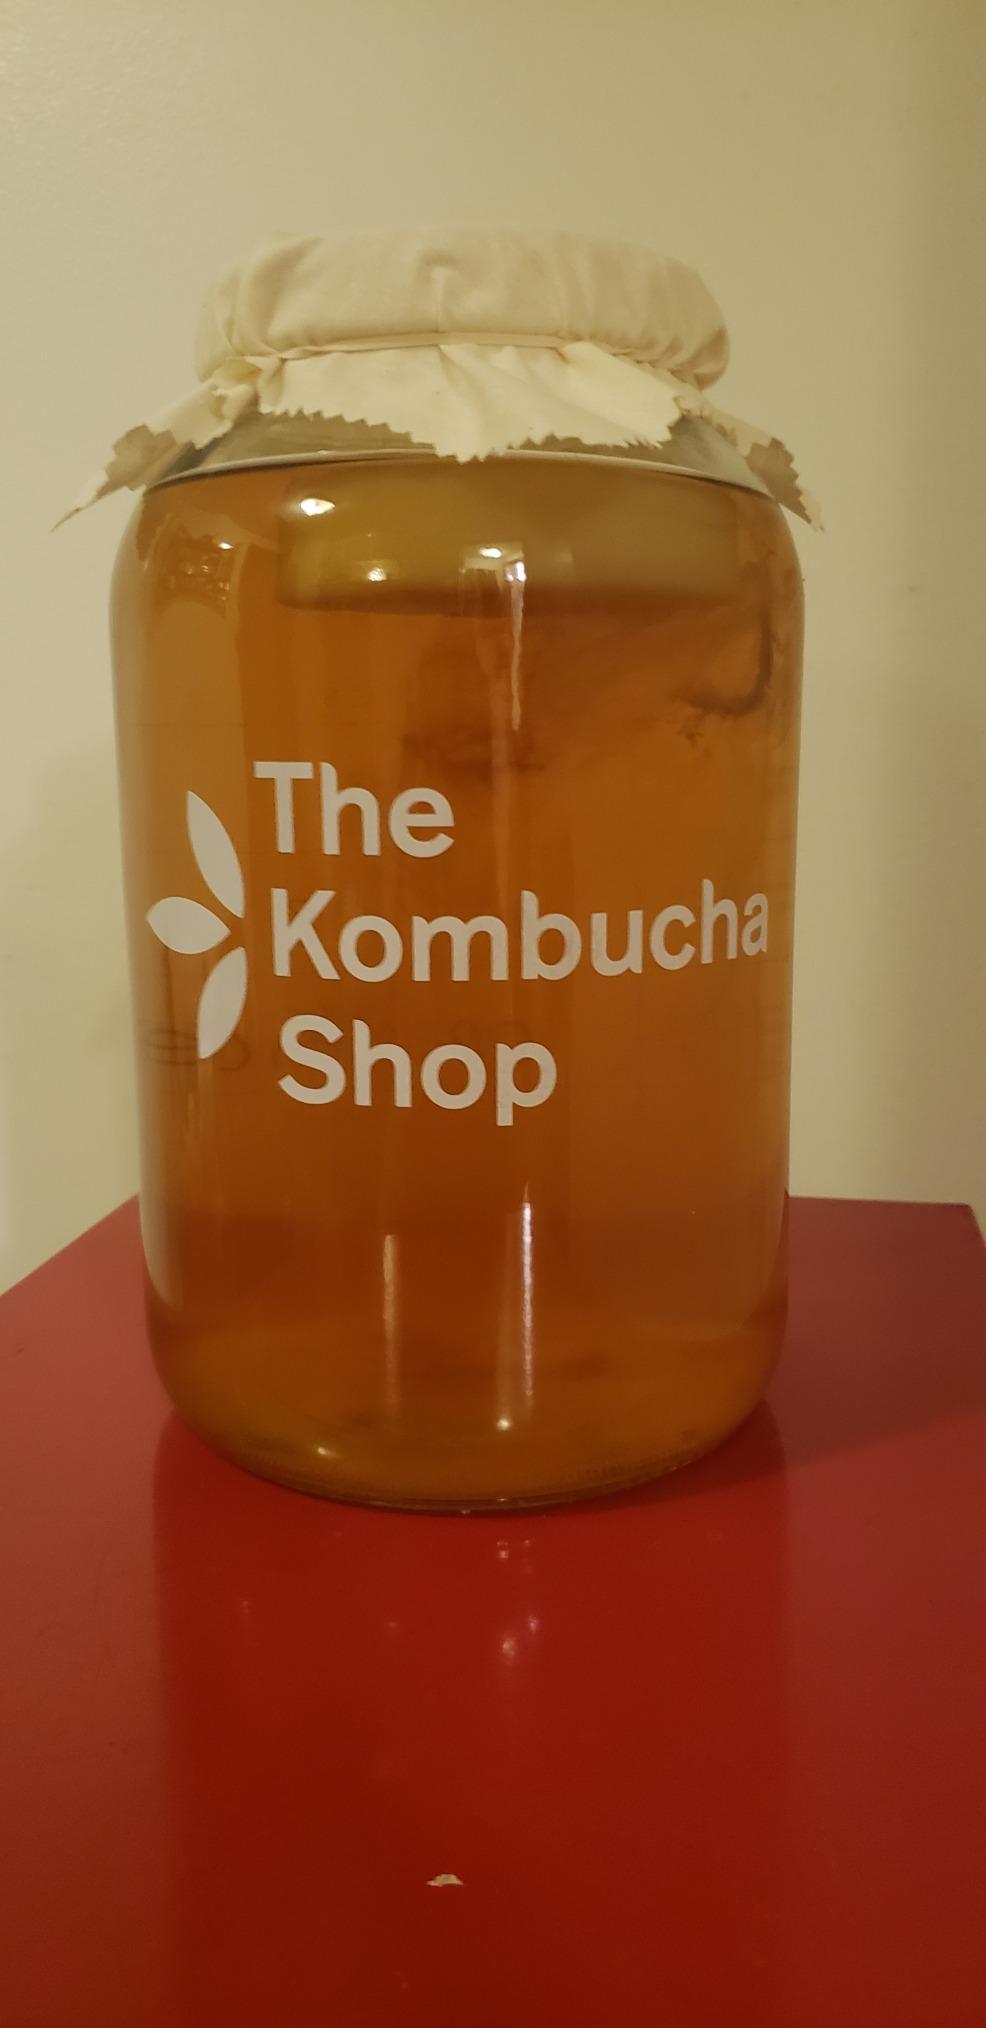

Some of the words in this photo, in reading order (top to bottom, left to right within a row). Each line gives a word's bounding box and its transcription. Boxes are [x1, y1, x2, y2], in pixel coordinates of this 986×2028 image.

[253, 761, 455, 857] The
[270, 878, 769, 982] Kombucha
[278, 1014, 557, 1126] Shop
